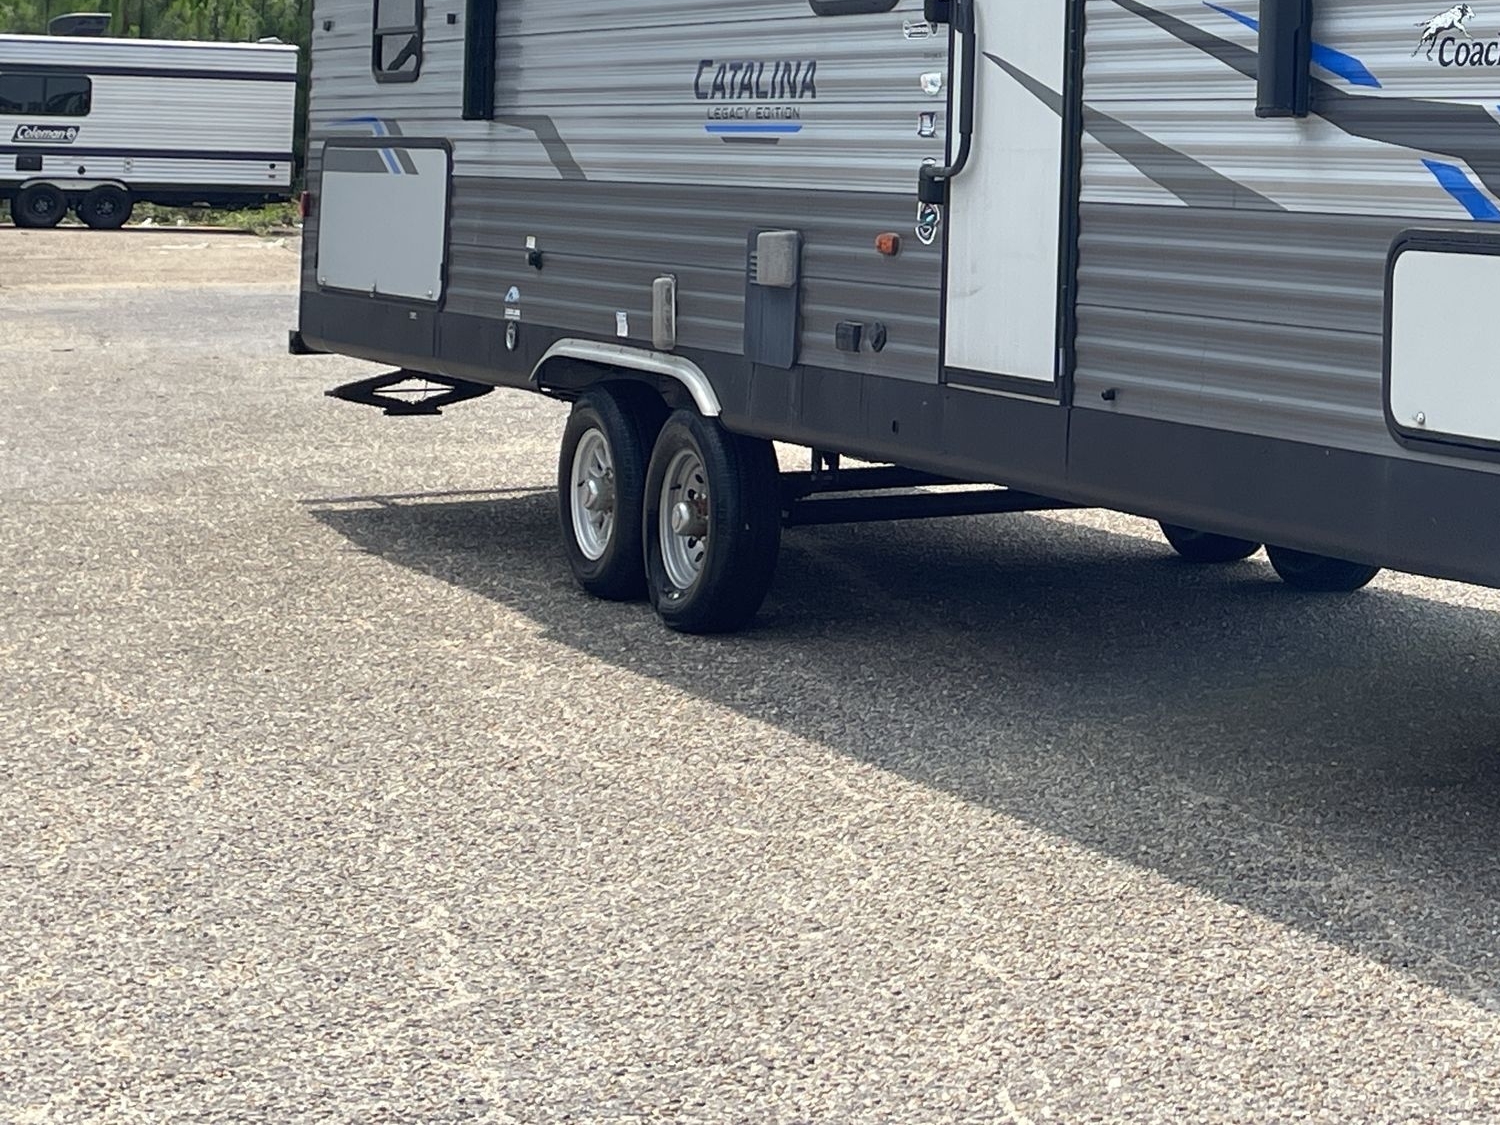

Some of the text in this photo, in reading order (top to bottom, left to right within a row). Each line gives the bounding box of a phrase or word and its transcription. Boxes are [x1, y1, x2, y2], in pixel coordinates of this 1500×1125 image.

[693, 59, 817, 100] CATALINA
[706, 107, 801, 120] LEGACY EDITION
[17, 125, 67, 140] Coleman
